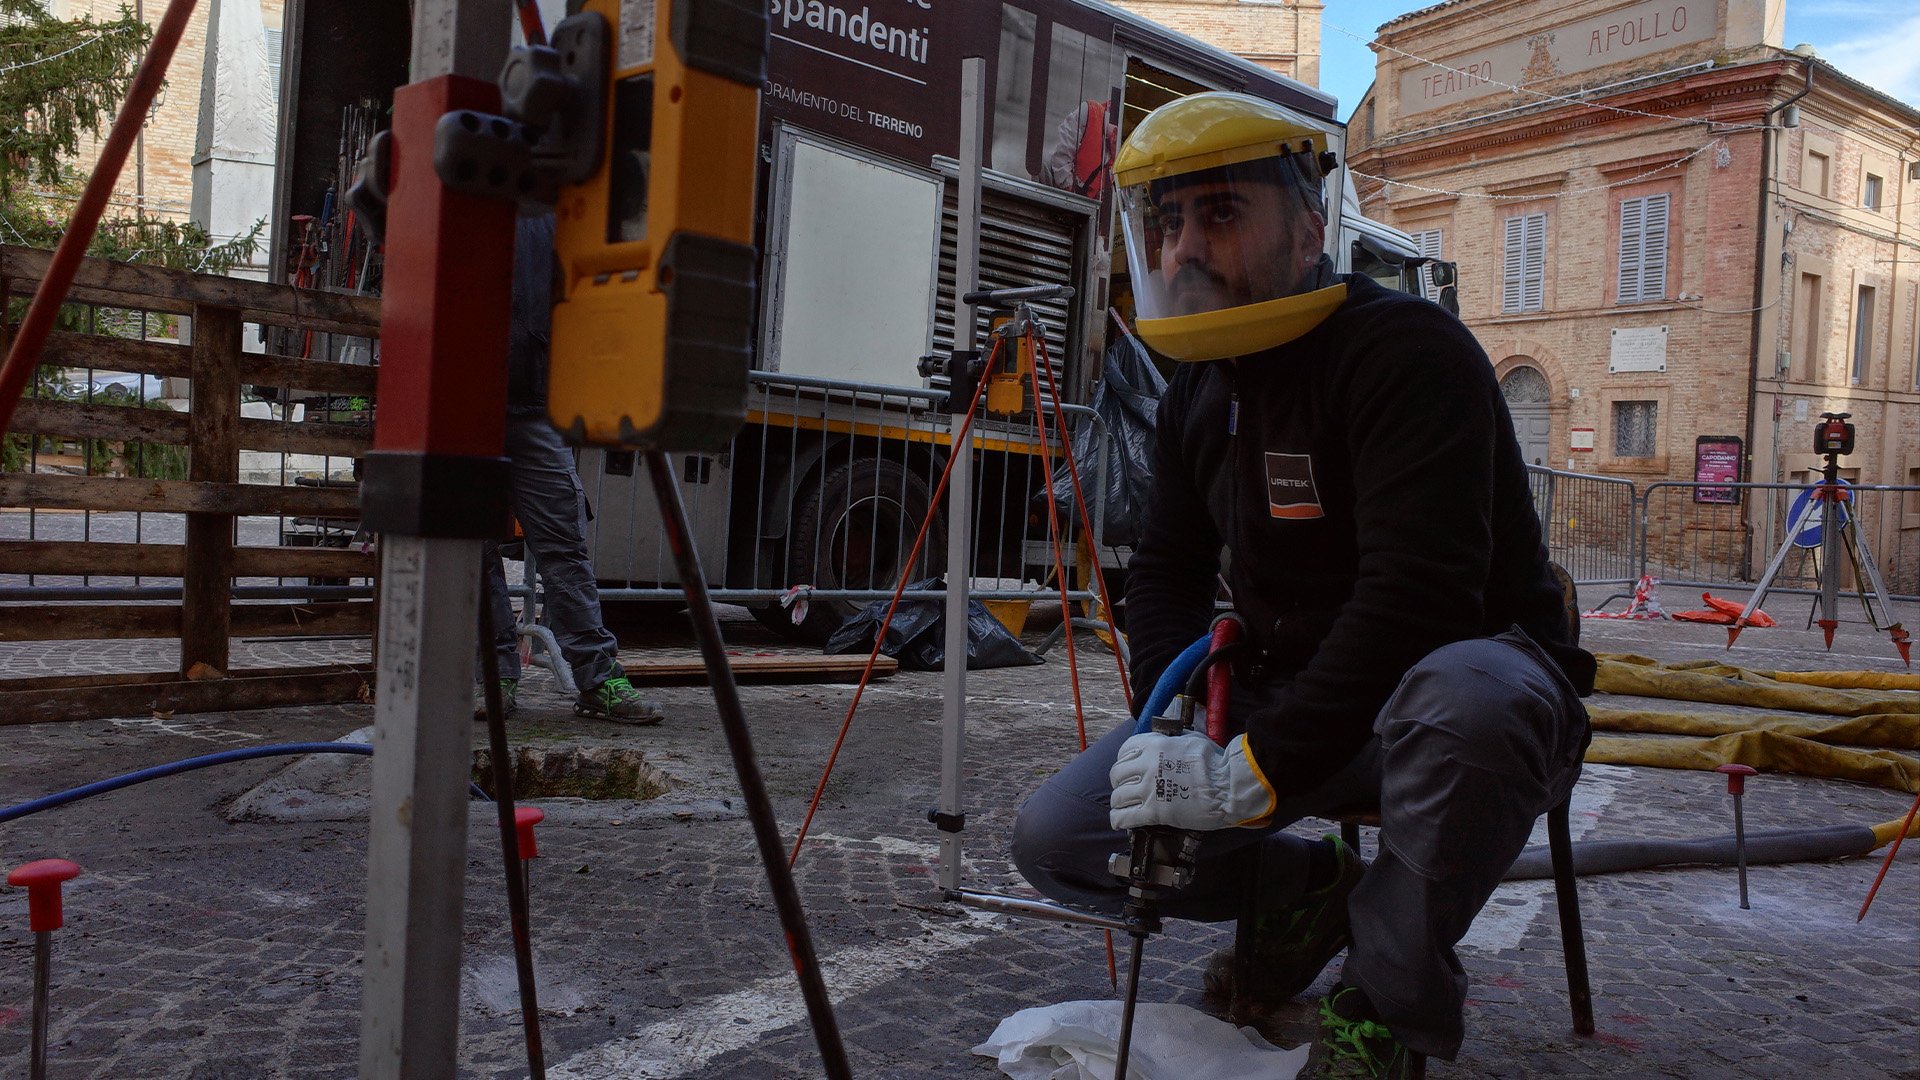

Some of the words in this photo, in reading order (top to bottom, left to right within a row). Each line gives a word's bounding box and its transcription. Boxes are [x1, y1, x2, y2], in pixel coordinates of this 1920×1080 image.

[1421, 60, 1493, 100] TEATRO
[1588, 6, 1687, 57] APOLLO
[840, 103, 864, 123] DEL
[867, 111, 924, 140] TERRENO
[1270, 477, 1309, 488] URETEK
